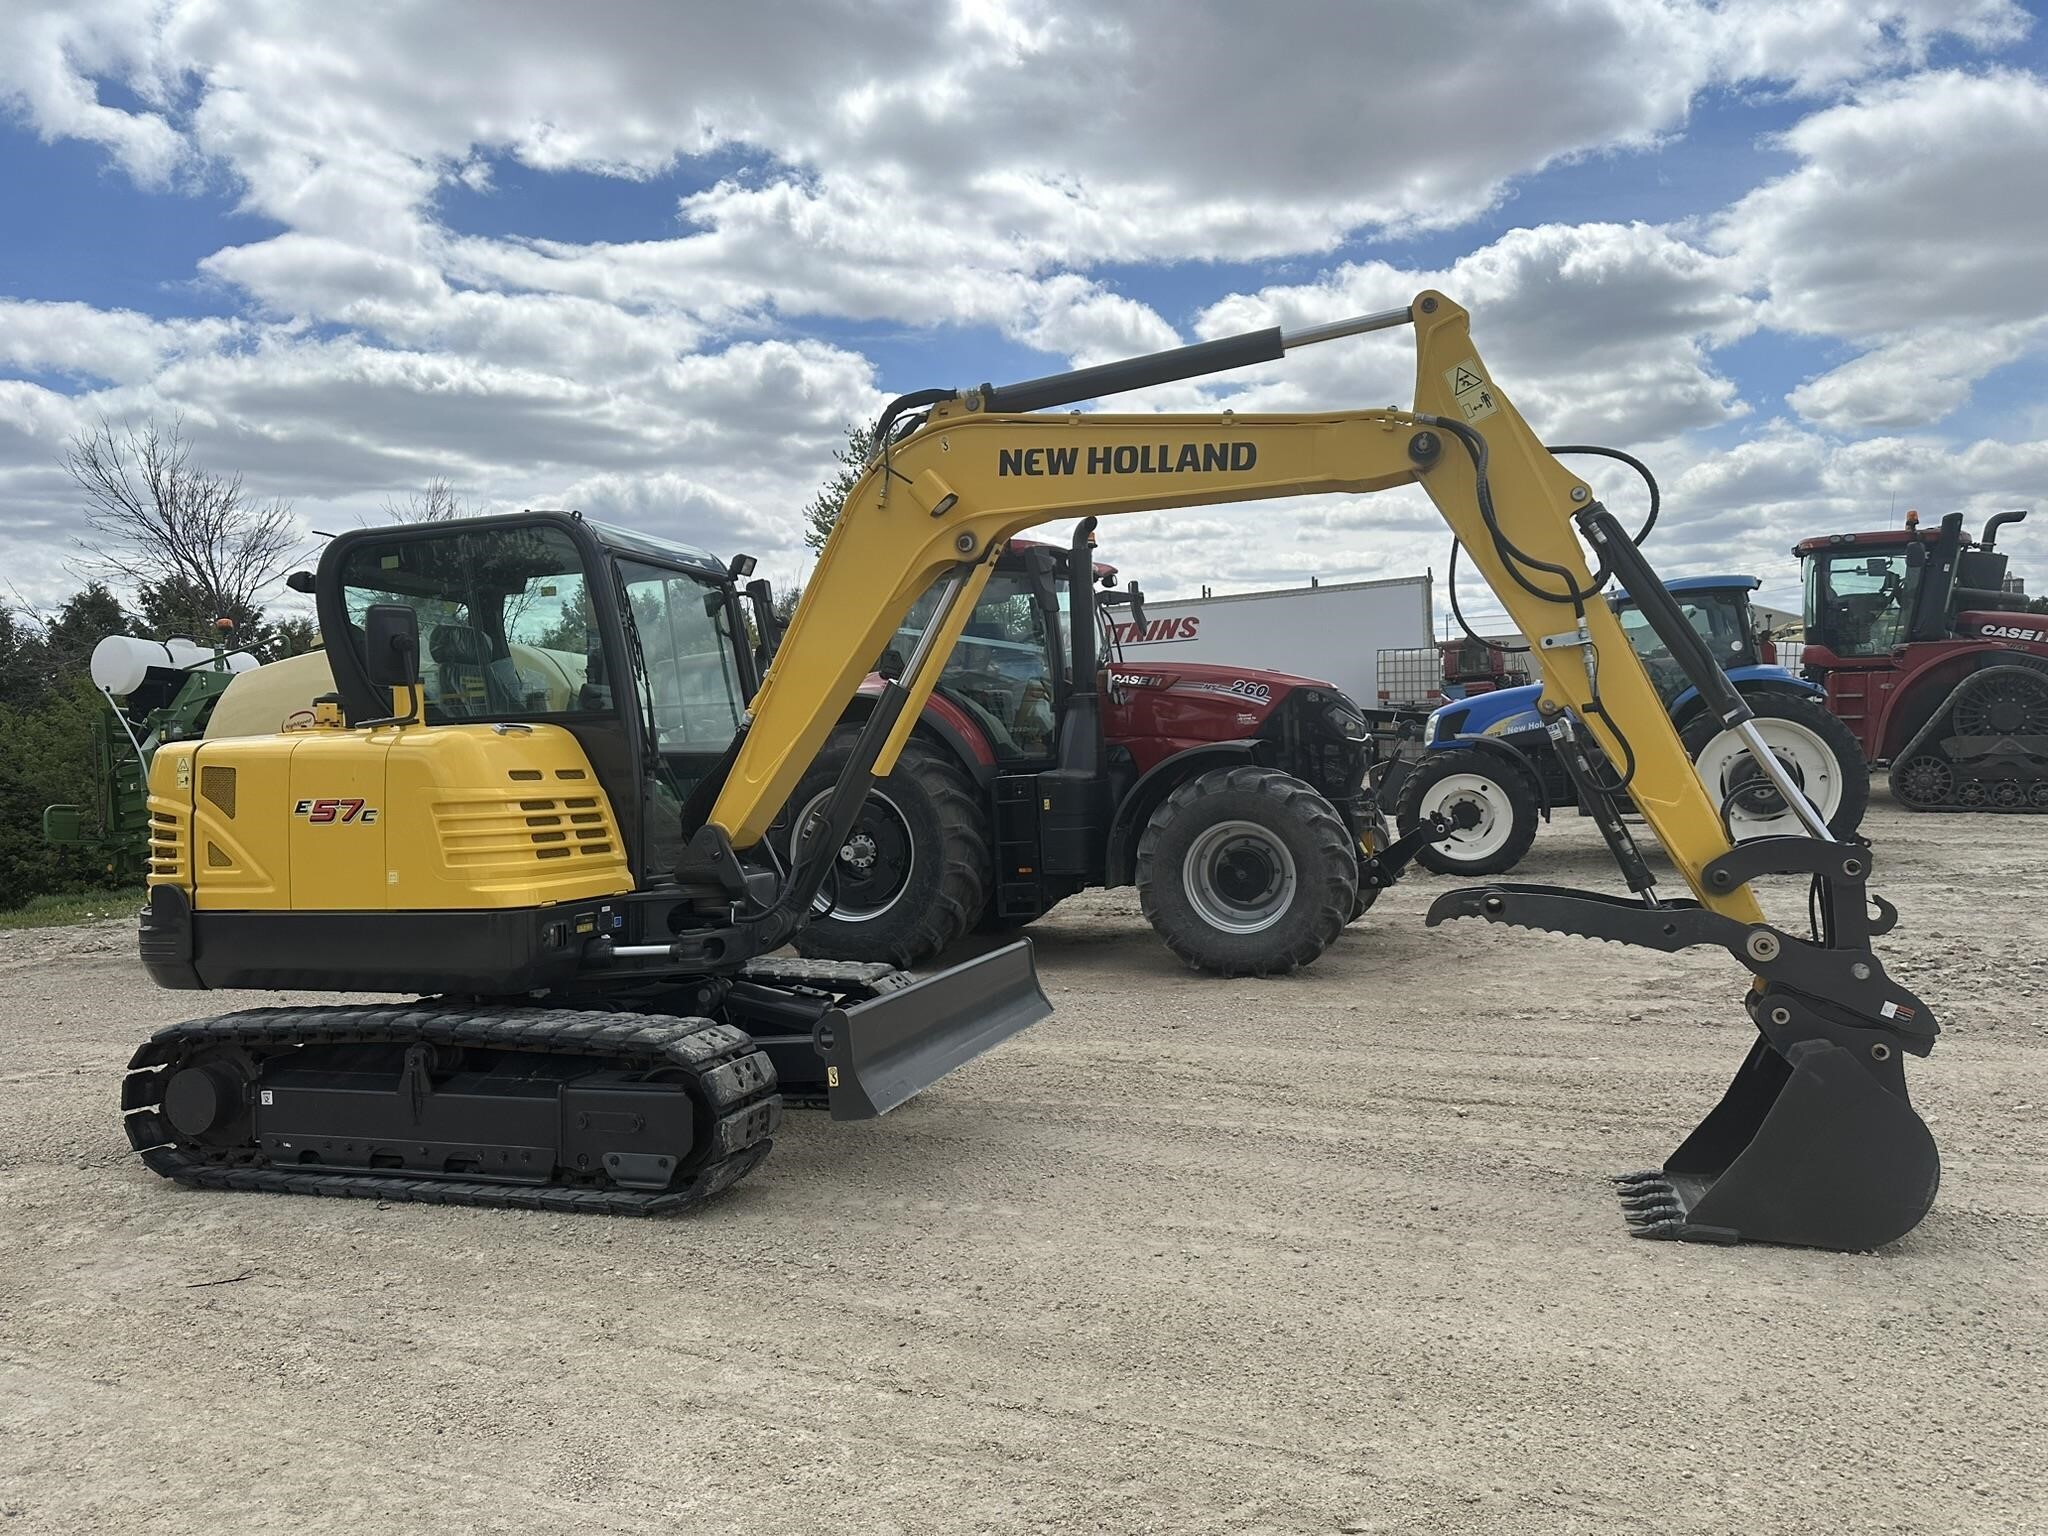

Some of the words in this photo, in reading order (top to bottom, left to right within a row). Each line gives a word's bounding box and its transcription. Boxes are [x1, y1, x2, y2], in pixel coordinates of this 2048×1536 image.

[999, 448, 1079, 477] NEW
[1086, 442, 1258, 475] HOLLAND
[1231, 679, 1270, 698] 260
[1507, 725, 1526, 735] New
